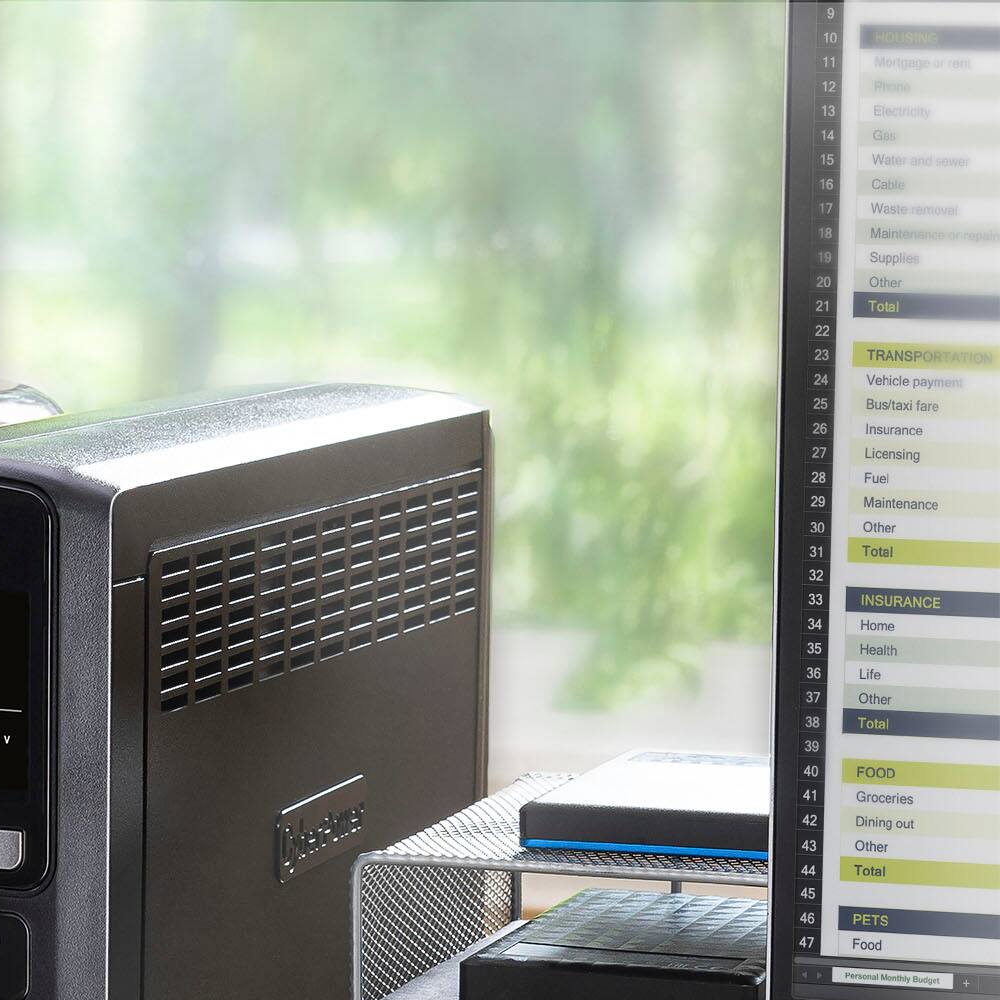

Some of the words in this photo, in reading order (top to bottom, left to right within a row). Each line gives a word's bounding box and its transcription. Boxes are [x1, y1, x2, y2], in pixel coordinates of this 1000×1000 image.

[827, 8, 835, 19] 9
[824, 32, 837, 43] 10
[873, 31, 939, 44] HOUSING
[823, 57, 835, 68] 11
[874, 56, 930, 71] Mortgage
[947, 59, 970, 70] rent
[822, 81, 836, 93] 12
[874, 80, 911, 93] Phone
[822, 105, 835, 117] 13
[873, 104, 931, 119] Electricity
[821, 129, 834, 141] 14
[873, 129, 896, 141] Gas
[821, 154, 834, 165] 15
[872, 154, 906, 167] Water
[910, 155, 932, 167] and
[936, 157, 969, 167] sewer
[819, 178, 834, 190] 16
[872, 178, 905, 190] Cable
[818, 203, 833, 215] 17
[871, 202, 907, 215] Waste
[911, 203, 958, 216] removal
[818, 227, 832, 239] 18
[870, 228, 945, 241] Maintenance
[818, 252, 832, 263] 19
[870, 252, 920, 266] Supplies
[816, 276, 831, 288] 20
[869, 276, 902, 288] Other
[815, 301, 830, 312] 21
[868, 300, 900, 313] Total
[815, 325, 830, 336] 22
[814, 349, 829, 361] 23
[867, 349, 993, 365] TRANSPORTATION
[813, 374, 828, 386] 24
[866, 374, 910, 387] Vehicle
[913, 377, 963, 390] payment
[813, 398, 828, 409] 25
[866, 399, 913, 412] Bus/taxi
[916, 400, 939, 412] fare
[812, 423, 827, 435] 26
[865, 424, 923, 436] Insurance
[811, 447, 827, 459] 27
[864, 448, 920, 464] Licensing
[811, 472, 826, 484] 28
[864, 472, 889, 484] Fuel
[810, 496, 825, 508] 29
[863, 496, 939, 511] Maintenance
[810, 522, 825, 533] 30
[863, 521, 896, 534] Other
[809, 546, 824, 558] 31
[862, 545, 894, 558] Total
[808, 570, 824, 581] 32
[808, 594, 823, 606] 33
[861, 594, 941, 609] INSURANCE
[807, 618, 823, 630] 34
[860, 619, 895, 632] Home
[807, 643, 822, 654] 35
[859, 644, 898, 657] Health
[806, 667, 821, 679] 36
[859, 668, 881, 680] Life
[806, 692, 821, 703] 37
[858, 692, 892, 705] Other
[805, 716, 820, 728] 38
[857, 717, 889, 730] Total
[4, 735, 10, 745] V
[804, 740, 819, 752] 39
[803, 766, 819, 777] 40
[856, 766, 896, 779] FOOD
[803, 790, 817, 801] 41
[856, 791, 914, 805] Groceries
[802, 815, 818, 826] 42
[855, 816, 892, 831] Dining
[895, 819, 915, 830] out
[801, 840, 817, 852] 43
[855, 840, 888, 853] Other
[801, 865, 816, 876] 44
[854, 864, 886, 877] Total
[800, 888, 816, 899] 45
[800, 912, 815, 924] 46
[852, 913, 889, 927] PETS
[799, 937, 815, 949] 47
[852, 938, 882, 951] Food
[844, 971, 879, 981] Personal
[880, 974, 911, 984] Monthly
[912, 975, 940, 985] Budget
